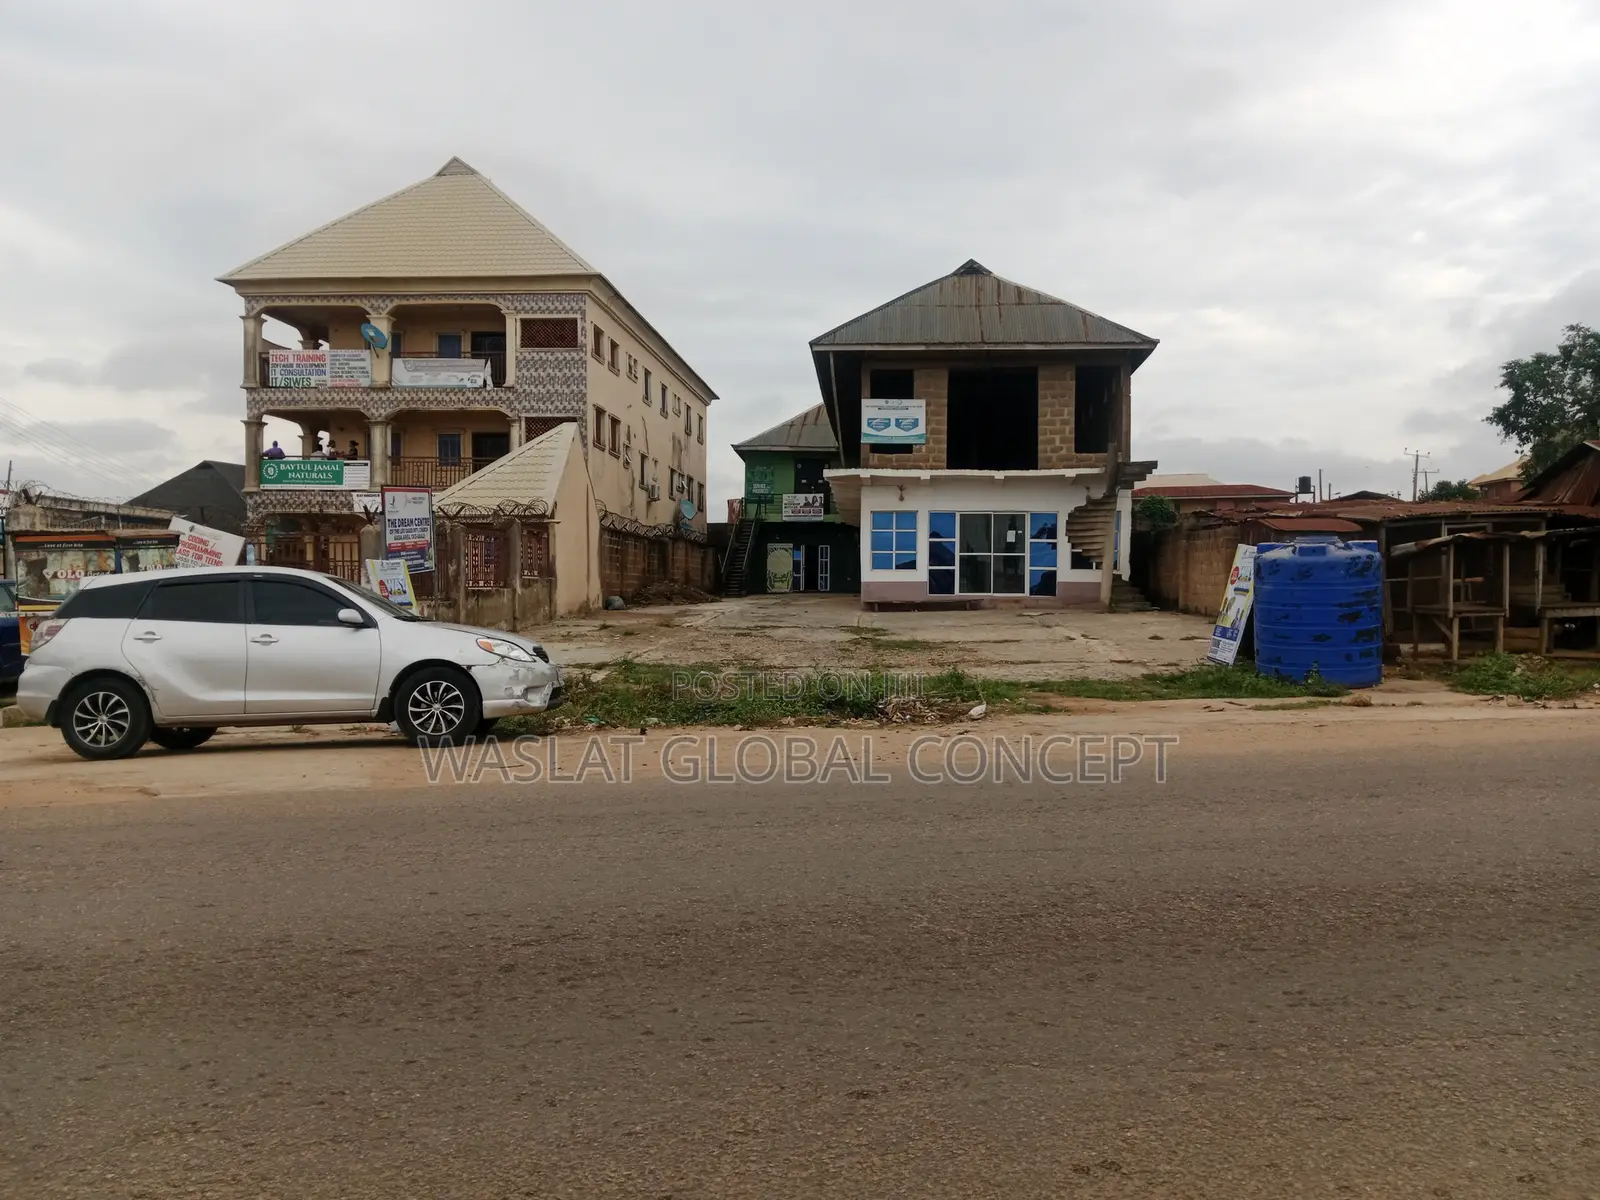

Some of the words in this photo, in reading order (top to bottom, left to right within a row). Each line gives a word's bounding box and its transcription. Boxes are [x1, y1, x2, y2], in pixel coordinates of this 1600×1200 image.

[271, 354, 289, 362] TECH
[292, 354, 326, 362] TRAINING
[271, 377, 312, 387] IT/SIWES
[280, 463, 311, 471] BAYTUL
[313, 463, 340, 472] JAMAL
[387, 518, 398, 528] THE
[398, 518, 414, 528] DREAM
[414, 517, 430, 527] CENTRE
[188, 534, 210, 546] CODING
[191, 552, 203, 561] FOR
[205, 556, 224, 567] TEENS
